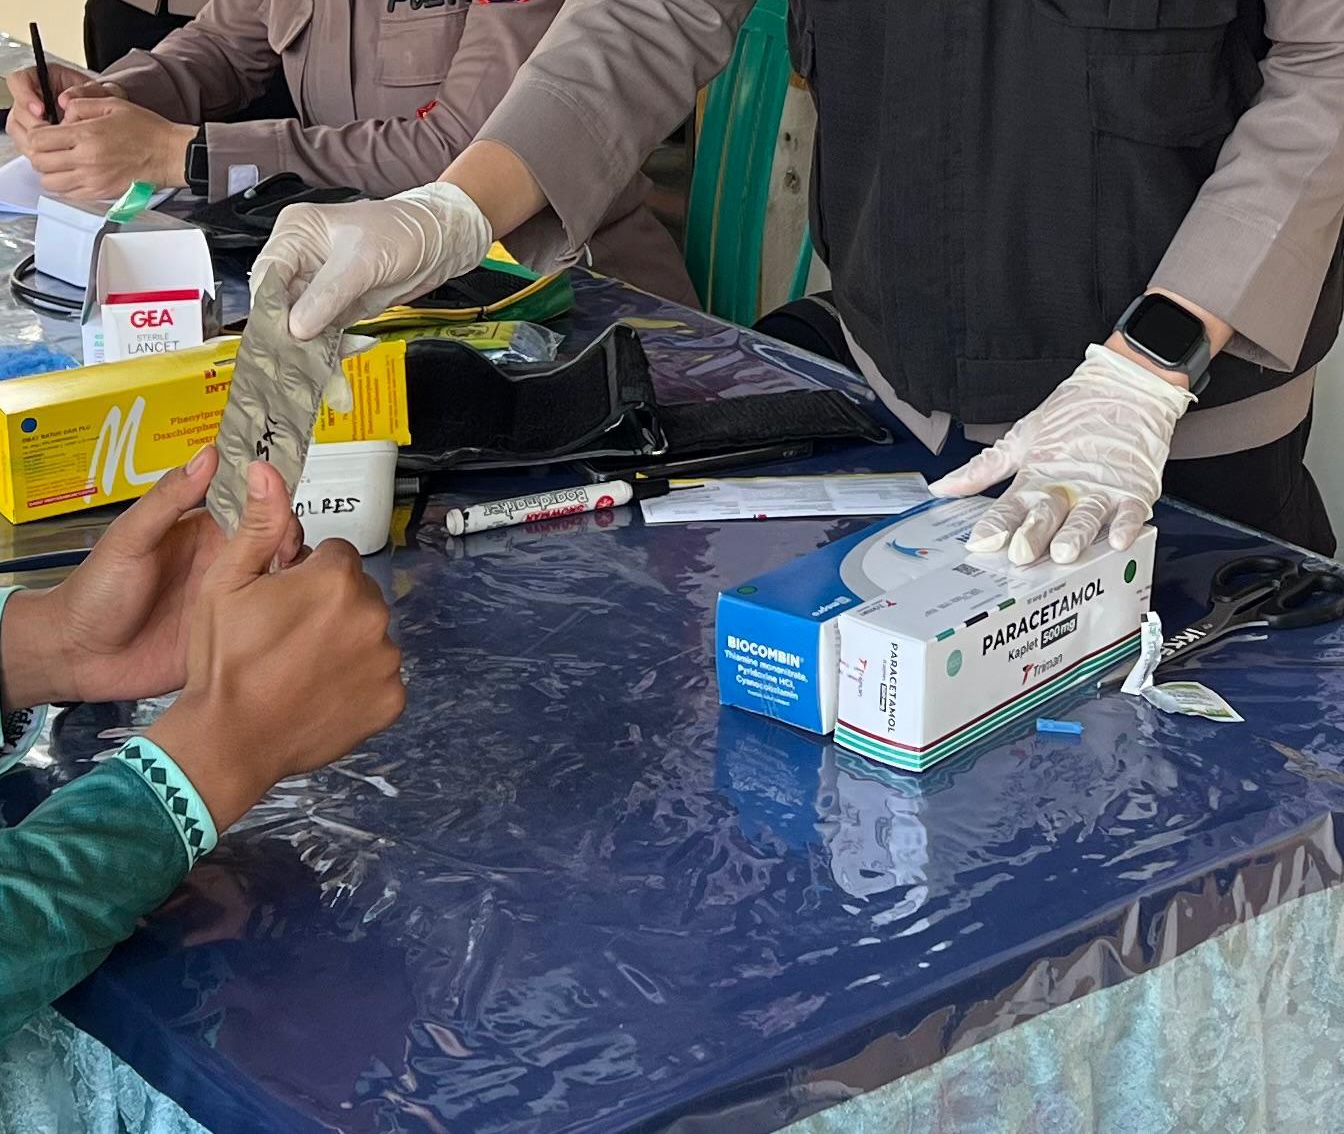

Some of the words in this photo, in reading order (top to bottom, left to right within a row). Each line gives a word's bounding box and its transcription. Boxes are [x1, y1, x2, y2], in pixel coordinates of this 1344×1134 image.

[130, 308, 174, 329] GEA
[128, 340, 180, 355] LANCET
[136, 332, 169, 342] STERILE
[293, 497, 360, 517] OLRES
[982, 578, 1105, 656] PARACETAMOL
[727, 635, 801, 669] BIOCOMBIN
[1008, 637, 1039, 662] Kaplet
[1033, 653, 1063, 677] Triman
[887, 642, 898, 733] PARACETAMOL
